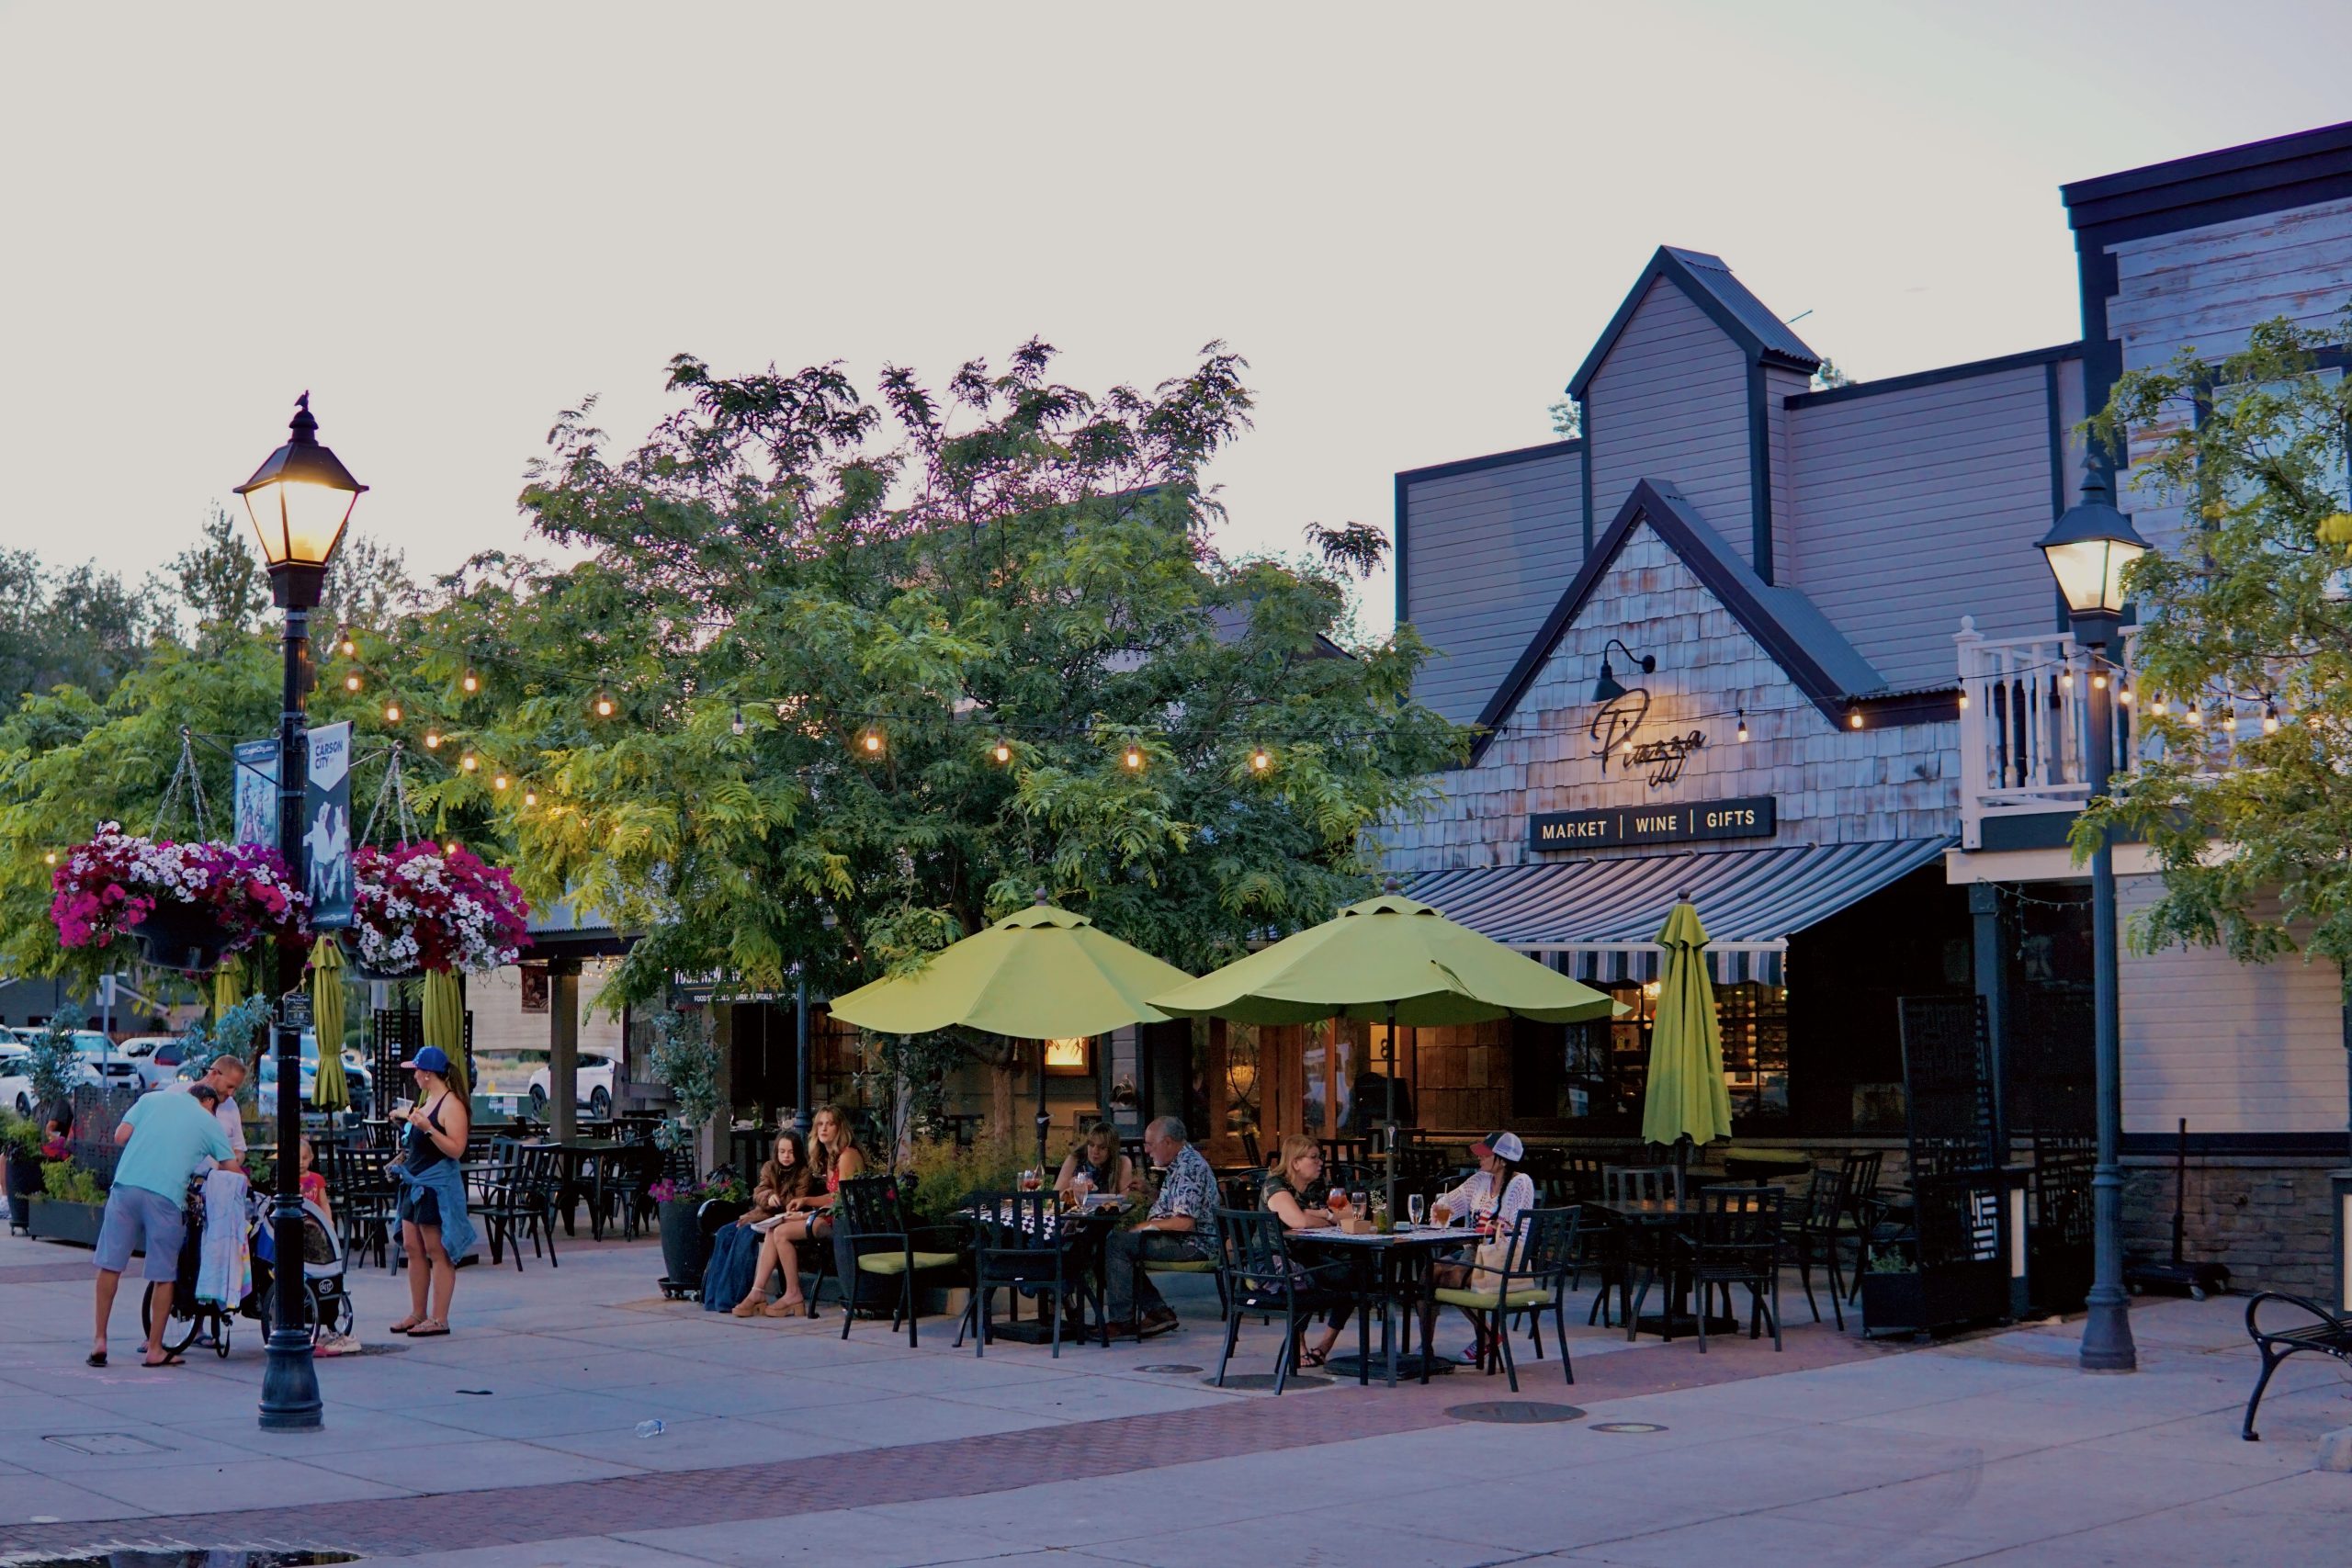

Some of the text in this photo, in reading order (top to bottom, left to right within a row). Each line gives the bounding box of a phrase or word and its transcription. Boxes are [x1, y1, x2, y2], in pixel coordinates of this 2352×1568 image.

[315, 739, 343, 757] CARSON
[315, 756, 330, 770] CITY
[1543, 809, 1756, 840] MARKET WINE GIFTS
[707, 994, 730, 1002] SPALS
